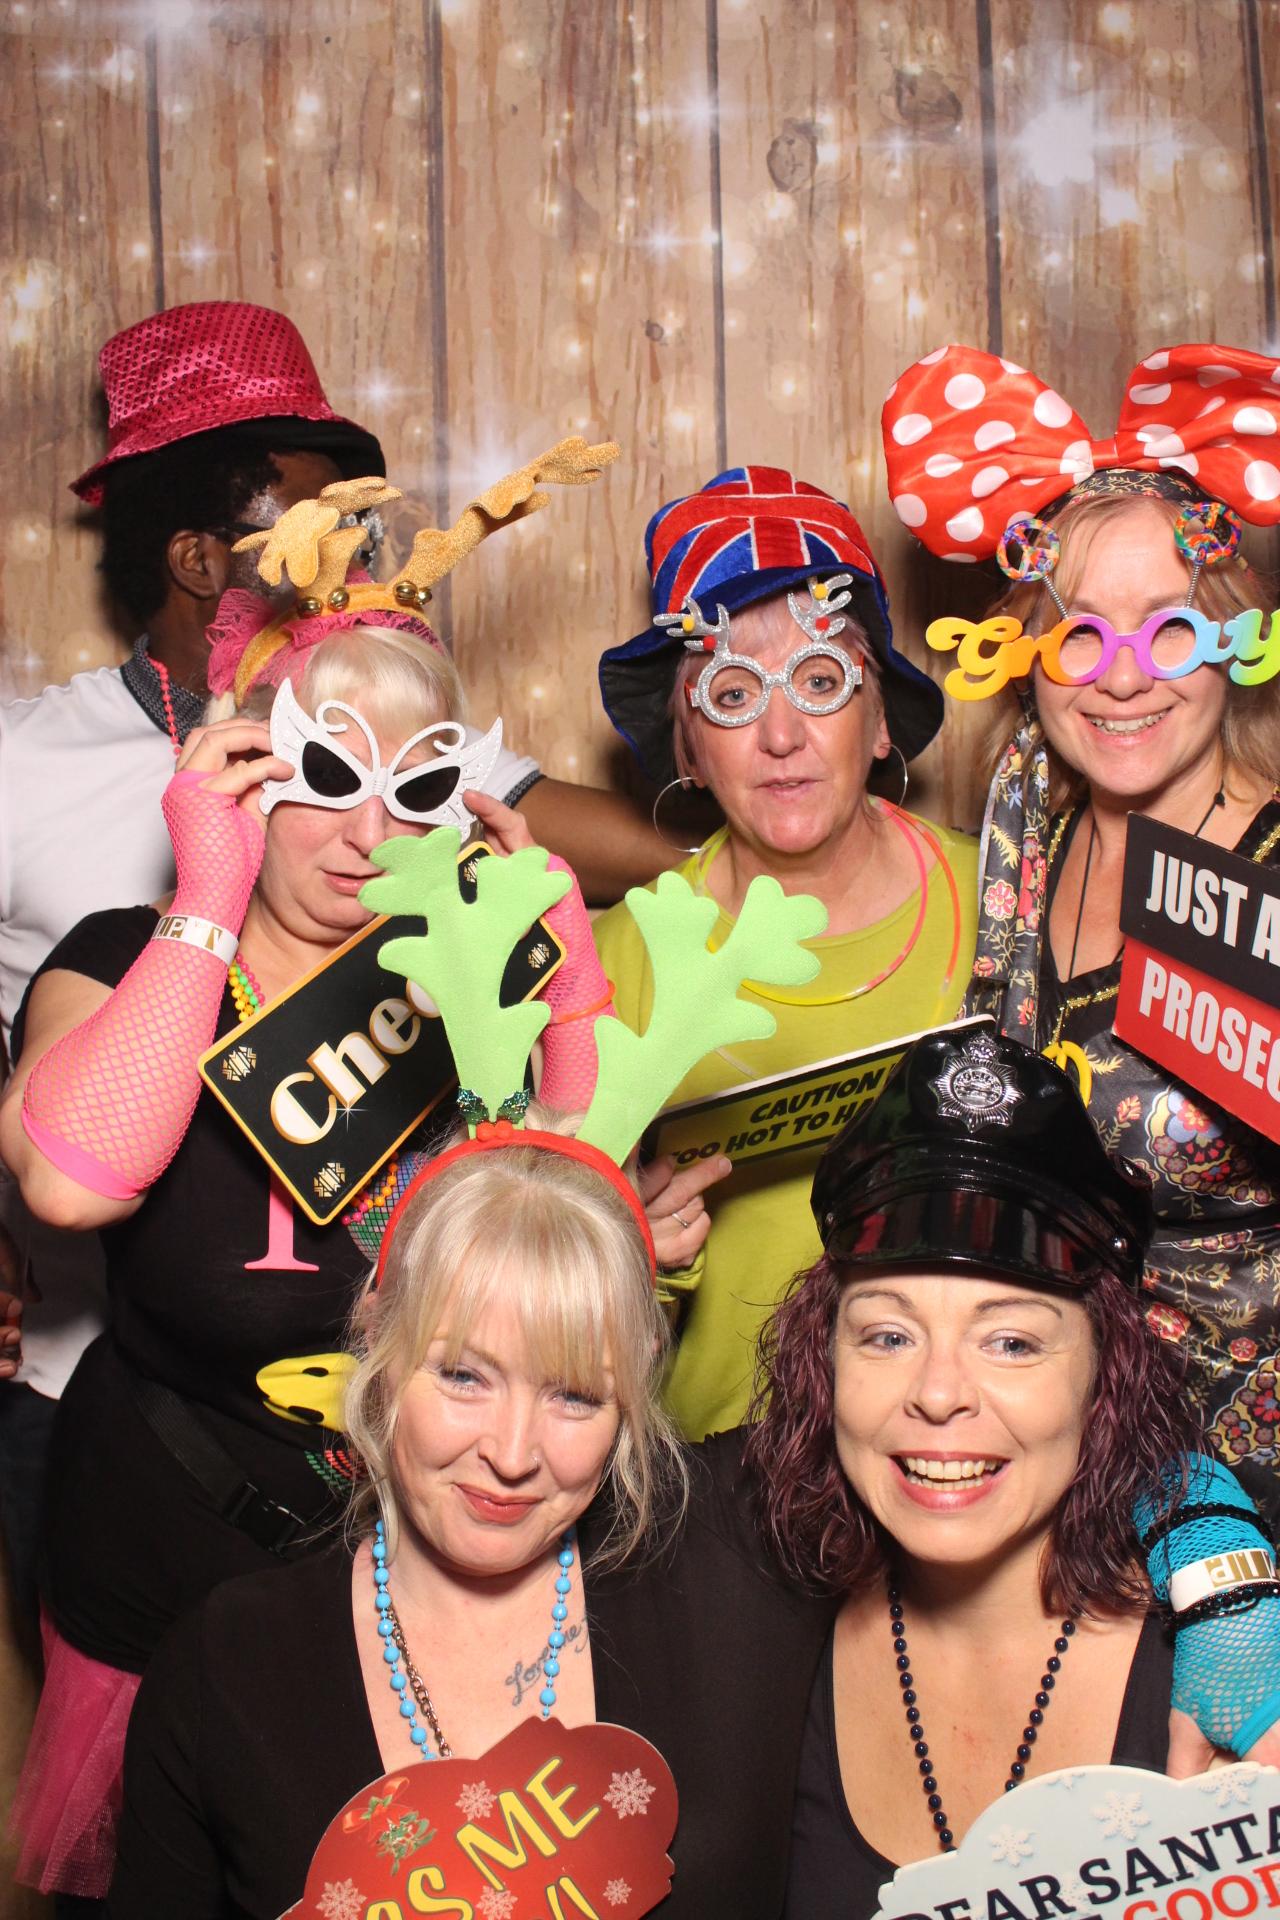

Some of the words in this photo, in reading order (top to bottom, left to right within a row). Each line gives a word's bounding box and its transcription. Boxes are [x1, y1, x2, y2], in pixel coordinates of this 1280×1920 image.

[925, 607, 1280, 701] Groovy
[1146, 850, 1248, 948] JUST
[153, 915, 189, 939] IP
[724, 1117, 789, 1154] HOT
[792, 1110, 831, 1137] TO
[1203, 1550, 1272, 1588] IP
[456, 1756, 601, 1892] ME
[890, 1874, 1077, 1920] AR
